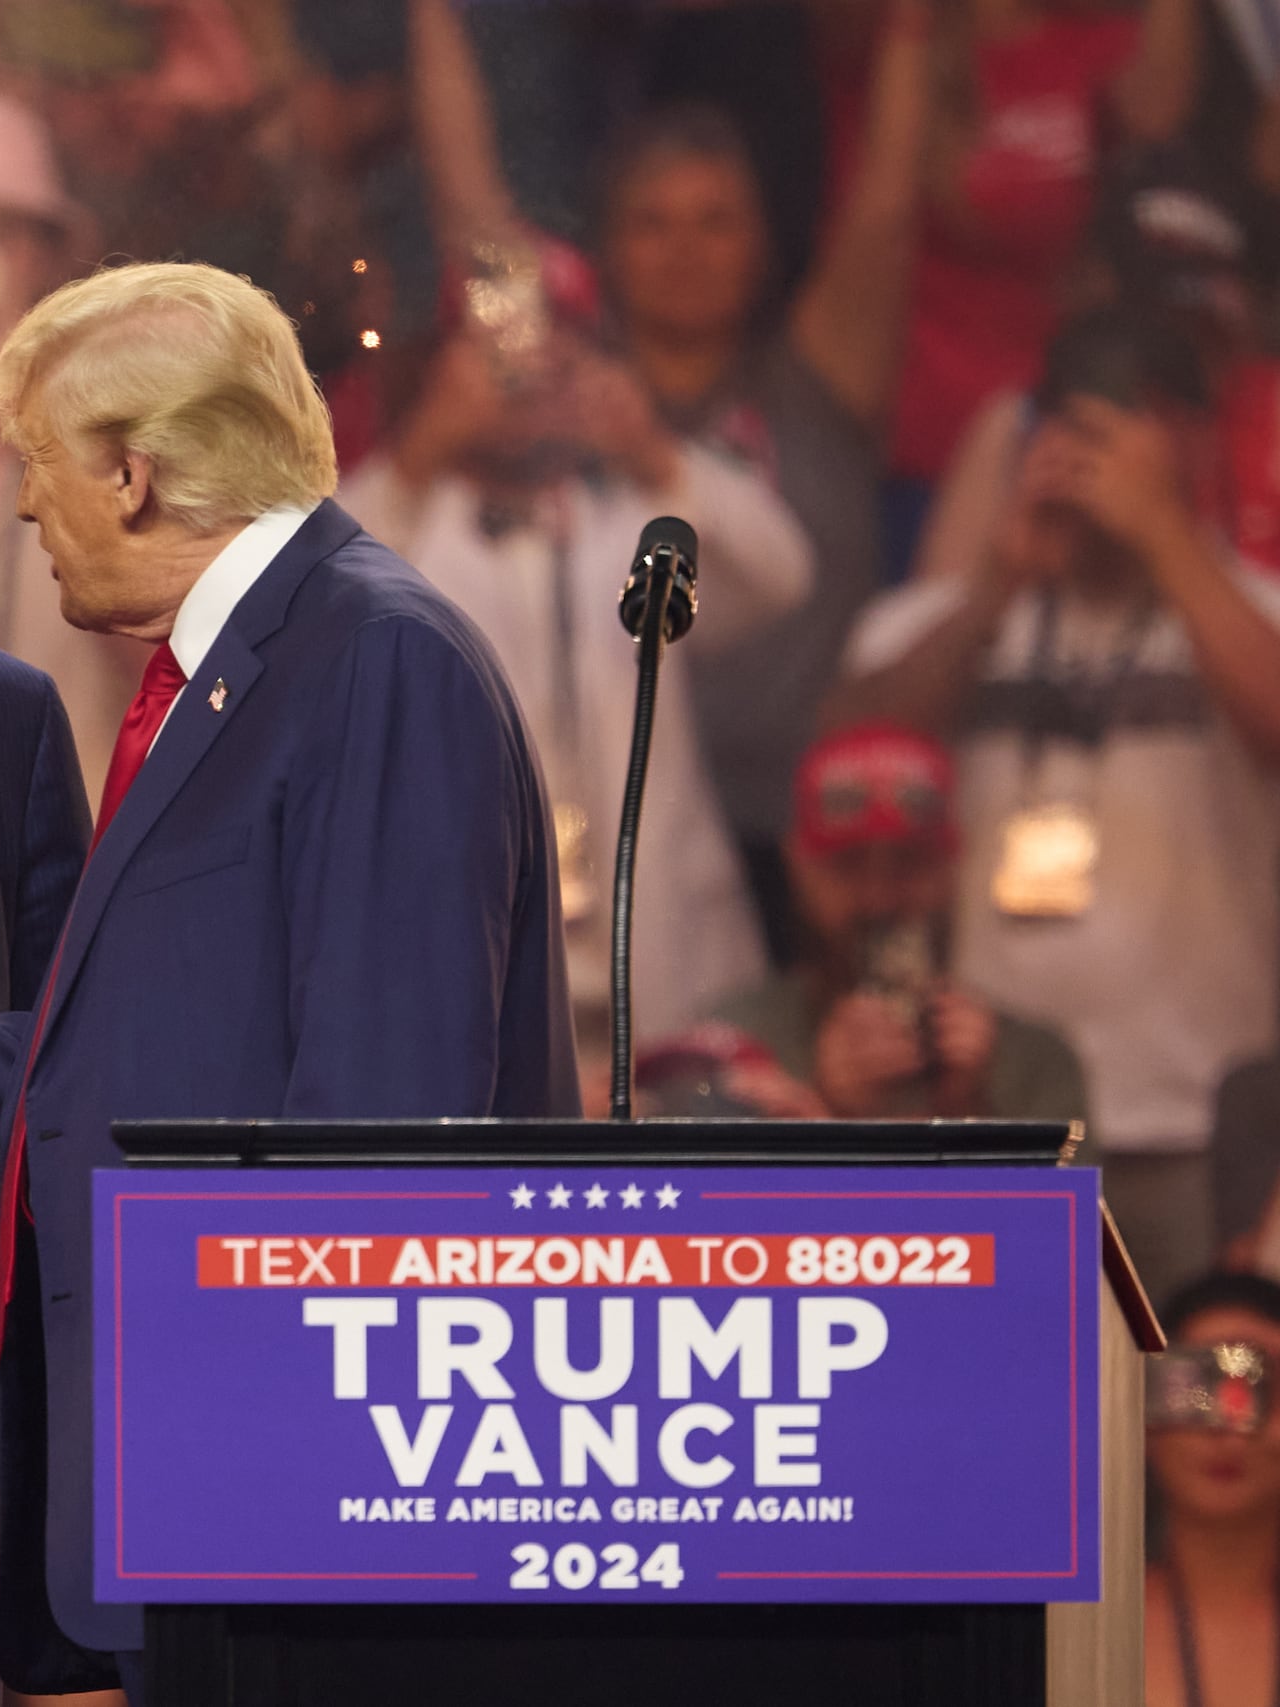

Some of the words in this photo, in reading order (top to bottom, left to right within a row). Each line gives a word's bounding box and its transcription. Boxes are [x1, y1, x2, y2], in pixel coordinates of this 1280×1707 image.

[221, 1237, 374, 1286] TEXT
[390, 1237, 673, 1286] ARIZONA
[687, 1237, 769, 1286] TO
[786, 1236, 972, 1286] 88022
[302, 1296, 889, 1401] TRUMP
[369, 1402, 822, 1488] VANCE
[339, 1496, 436, 1523] MAKE
[446, 1496, 601, 1523] AMERICA
[611, 1496, 723, 1523] GREAT
[733, 1496, 854, 1523] AGAIN!
[509, 1543, 685, 1591] 2024
